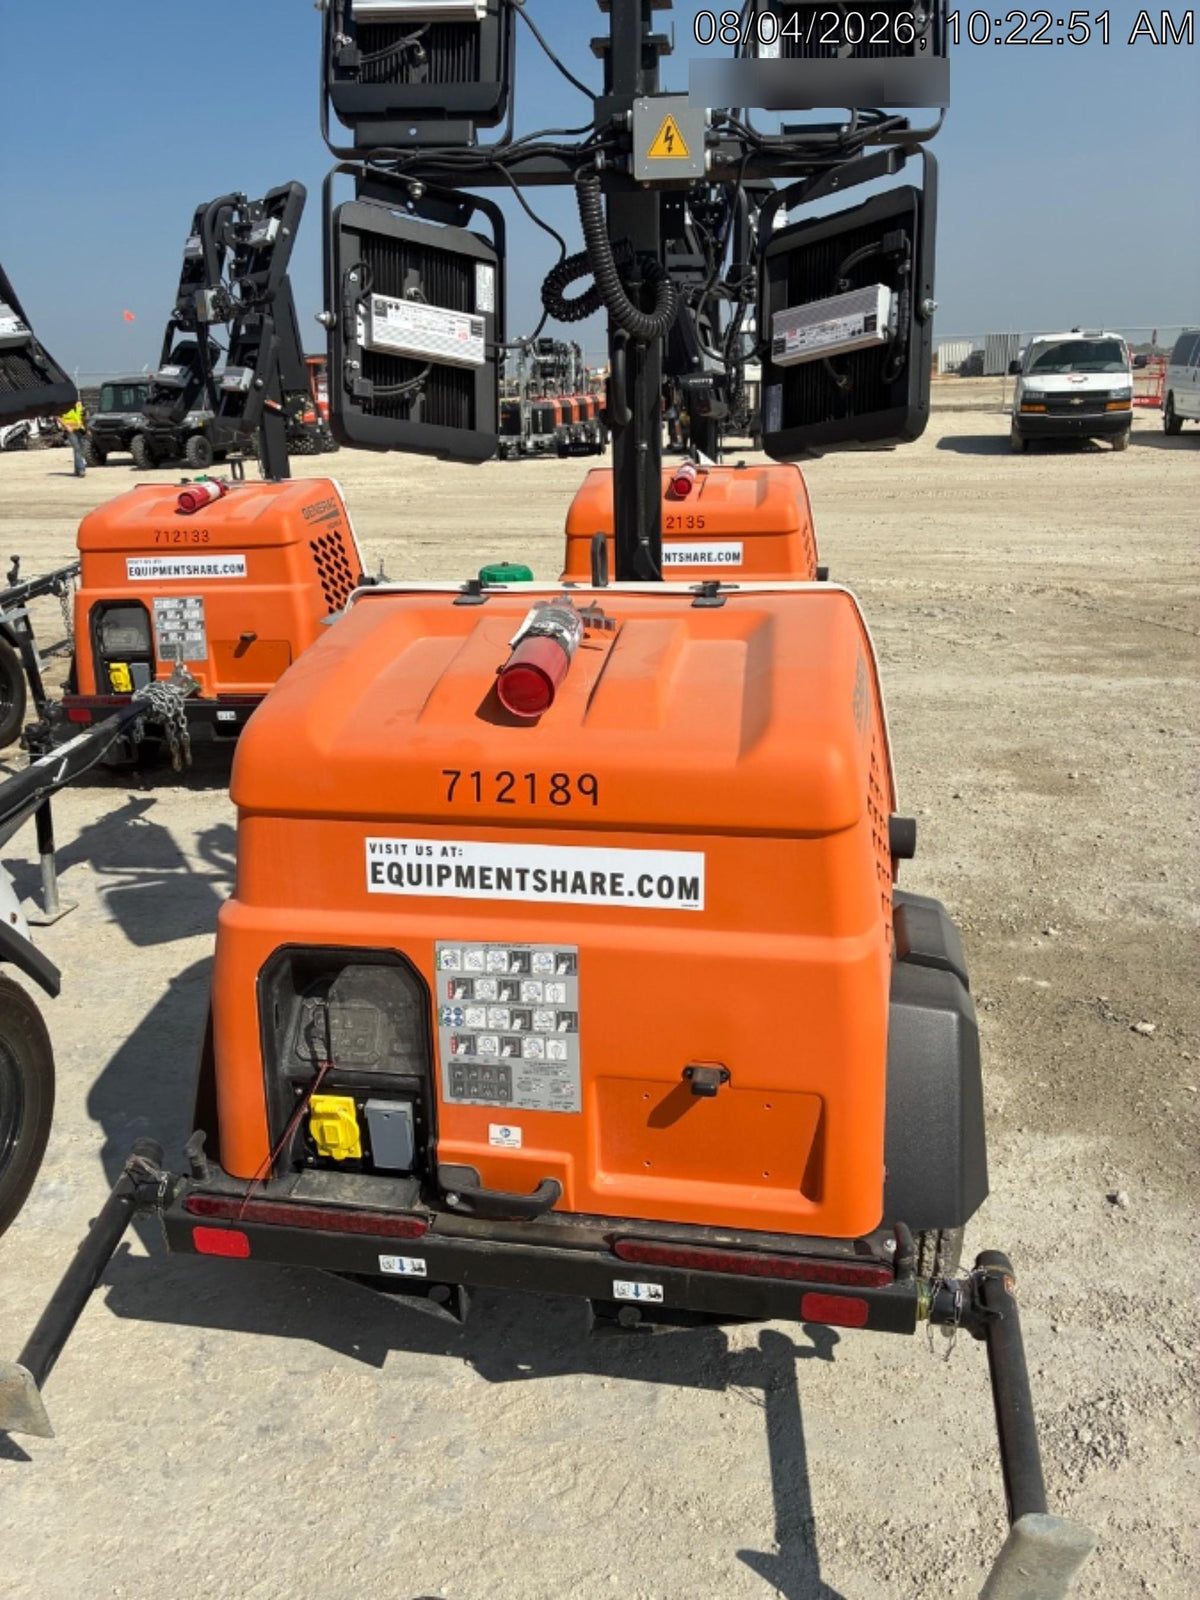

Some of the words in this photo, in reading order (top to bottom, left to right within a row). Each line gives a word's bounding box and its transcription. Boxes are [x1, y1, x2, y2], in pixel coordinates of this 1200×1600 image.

[666, 516, 705, 529] 2135
[153, 529, 211, 543] 712133
[129, 563, 244, 577] EQUIPMENTSHARE.COM
[441, 769, 599, 806] 712189
[369, 842, 408, 856] VISIT
[415, 844, 433, 857] US
[440, 845, 464, 858] AT:
[370, 861, 700, 901] EQUIPMENTSHARE.COM
